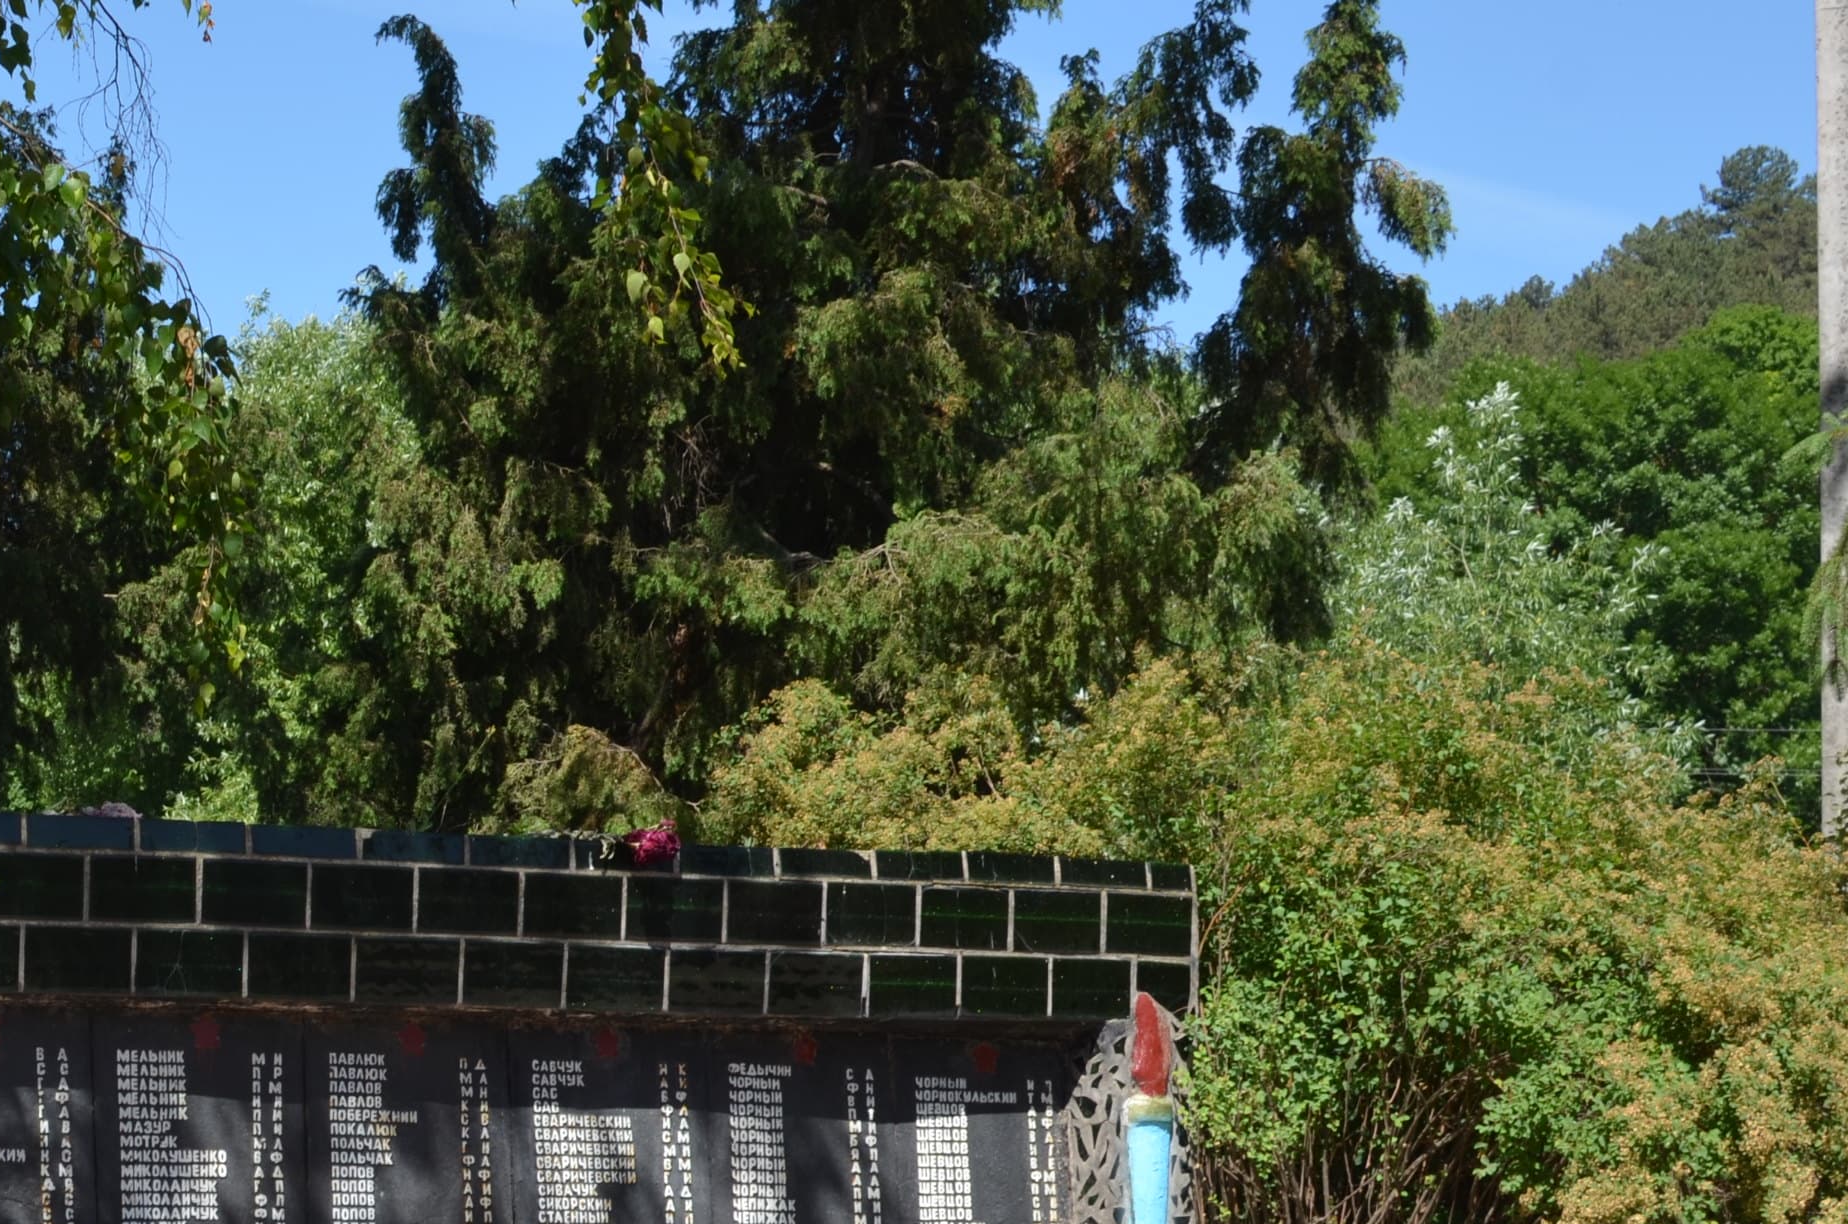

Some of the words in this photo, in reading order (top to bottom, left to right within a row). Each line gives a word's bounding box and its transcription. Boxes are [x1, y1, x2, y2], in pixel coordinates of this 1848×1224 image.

[117, 1049, 184, 1064] МЕЛЬНИК
[329, 1053, 384, 1067] ПАВЛЮК
[117, 1064, 185, 1078] МЕЛЬНИК
[330, 1067, 386, 1081] ПАВЛЮК
[118, 1078, 186, 1092] МЕЛЬНИК
[532, 1074, 584, 1087] САВЧУК
[330, 1081, 381, 1095] ПАВЛОВ
[533, 1087, 557, 1100] САС
[118, 1092, 187, 1106] МЕЛЬНИК
[330, 1095, 382, 1109] ПАВЛОВ
[119, 1106, 187, 1121] МЕЛЬНИК
[533, 1100, 559, 1114] САС
[119, 1121, 170, 1135] МАЗУР
[916, 1116, 967, 1129] ШЕВЦОВ
[331, 1123, 396, 1137] ПОКАЛЮК
[916, 1129, 967, 1142] ШЕВЦОВ
[331, 1137, 390, 1151] ПОЛЬЧАК
[917, 1142, 968, 1155] ШЕВЦОВ
[121, 1149, 226, 1164] МИКОЛУШЕНКО
[332, 1151, 393, 1165] ПОЛЬЧАК
[918, 1155, 969, 1168] ШЕВЦОВ
[121, 1164, 227, 1179] МИКОЛУШЕНКО
[332, 1165, 374, 1179] ПОПОВ
[918, 1168, 970, 1182] ШЕВЦОВ
[332, 1179, 374, 1193] ПОПОВ
[539, 1184, 598, 1197] СИВАЧУК
[919, 1182, 971, 1195] ШЕВЦОВ
[333, 1193, 375, 1207] ПОПОВ
[733, 1198, 795, 1212] ЧЕПИЖАК
[919, 1195, 971, 1208] ШЕВЦОВ
[333, 1207, 375, 1221] ПОПОВ
[733, 1212, 795, 1224] ЧЕПИЖАК
[920, 1208, 972, 1221] ШЕВЦОВ
